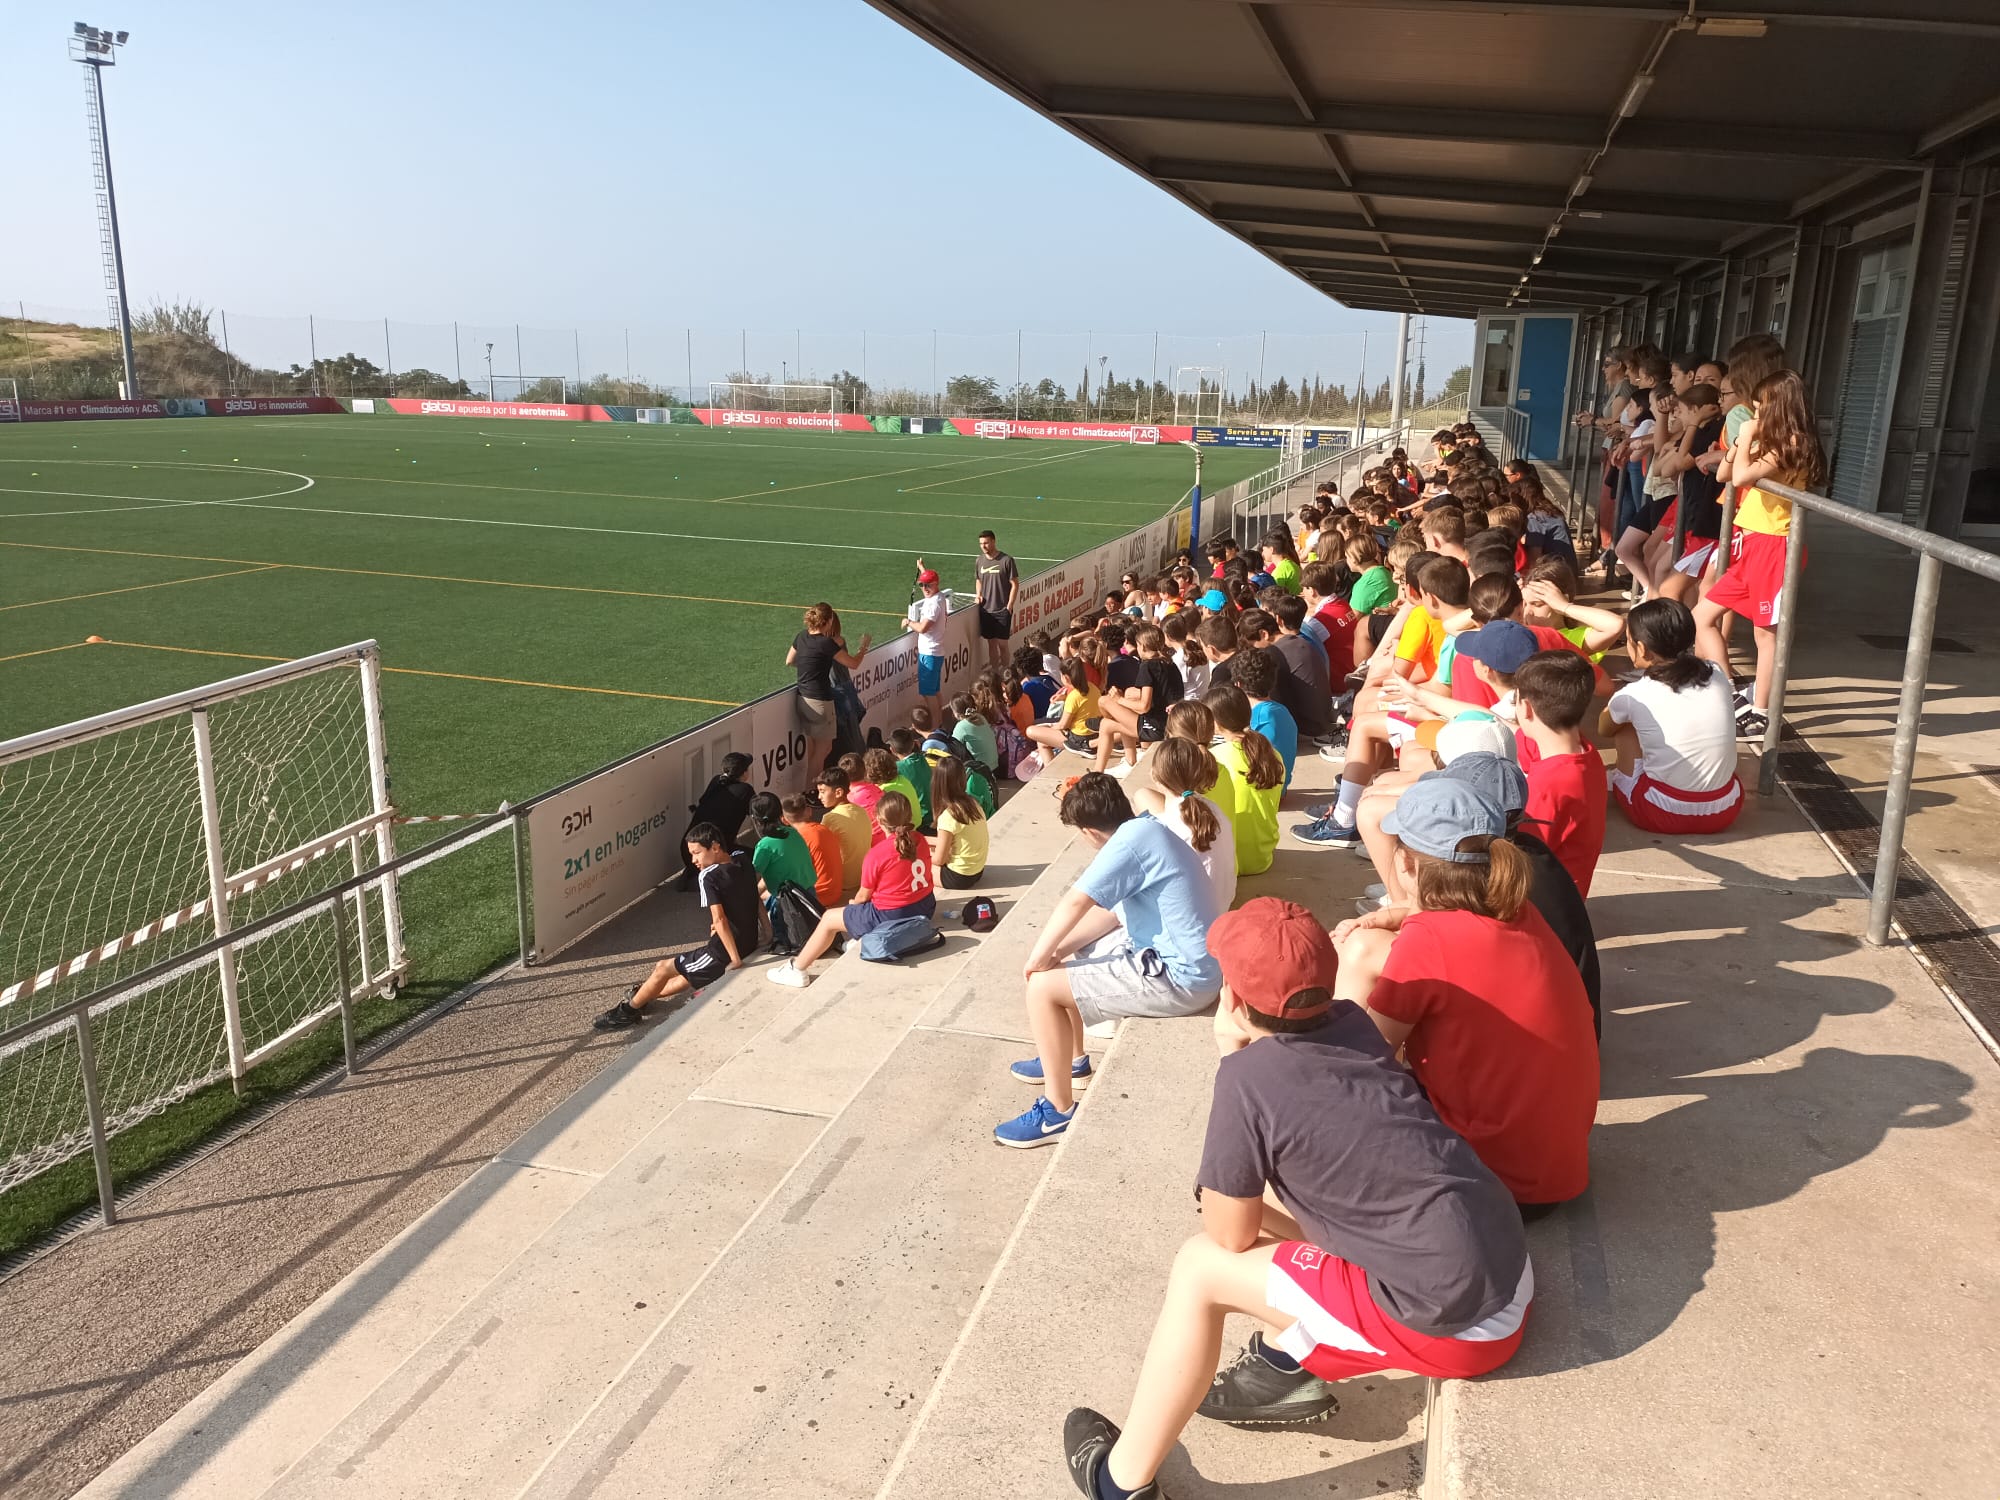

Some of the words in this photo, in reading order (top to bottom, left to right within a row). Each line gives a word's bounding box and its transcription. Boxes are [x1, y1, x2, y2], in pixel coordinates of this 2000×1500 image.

[25, 406, 52, 415] Marca
[54, 405, 65, 415] #1
[81, 404, 134, 414] Climatización
[142, 404, 160, 413] ACS.
[269, 400, 309, 410] innovación.
[458, 406, 491, 415] apuesta
[493, 407, 507, 416] por
[509, 406, 517, 415] la
[519, 407, 569, 417] aerotermia.
[764, 416, 783, 425] son
[787, 416, 843, 428] soluciones.
[1018, 425, 1045, 435] Marca
[1046, 426, 1058, 435] #1
[1060, 428, 1070, 436] en
[1072, 427, 1132, 438] Climatización
[1020, 581, 1041, 604] PLANXA
[1045, 570, 1065, 591] PINTURA
[944, 643, 969, 683] yelo
[762, 730, 807, 788] yelo
[564, 848, 591, 880] 2x1
[595, 841, 612, 862] en
